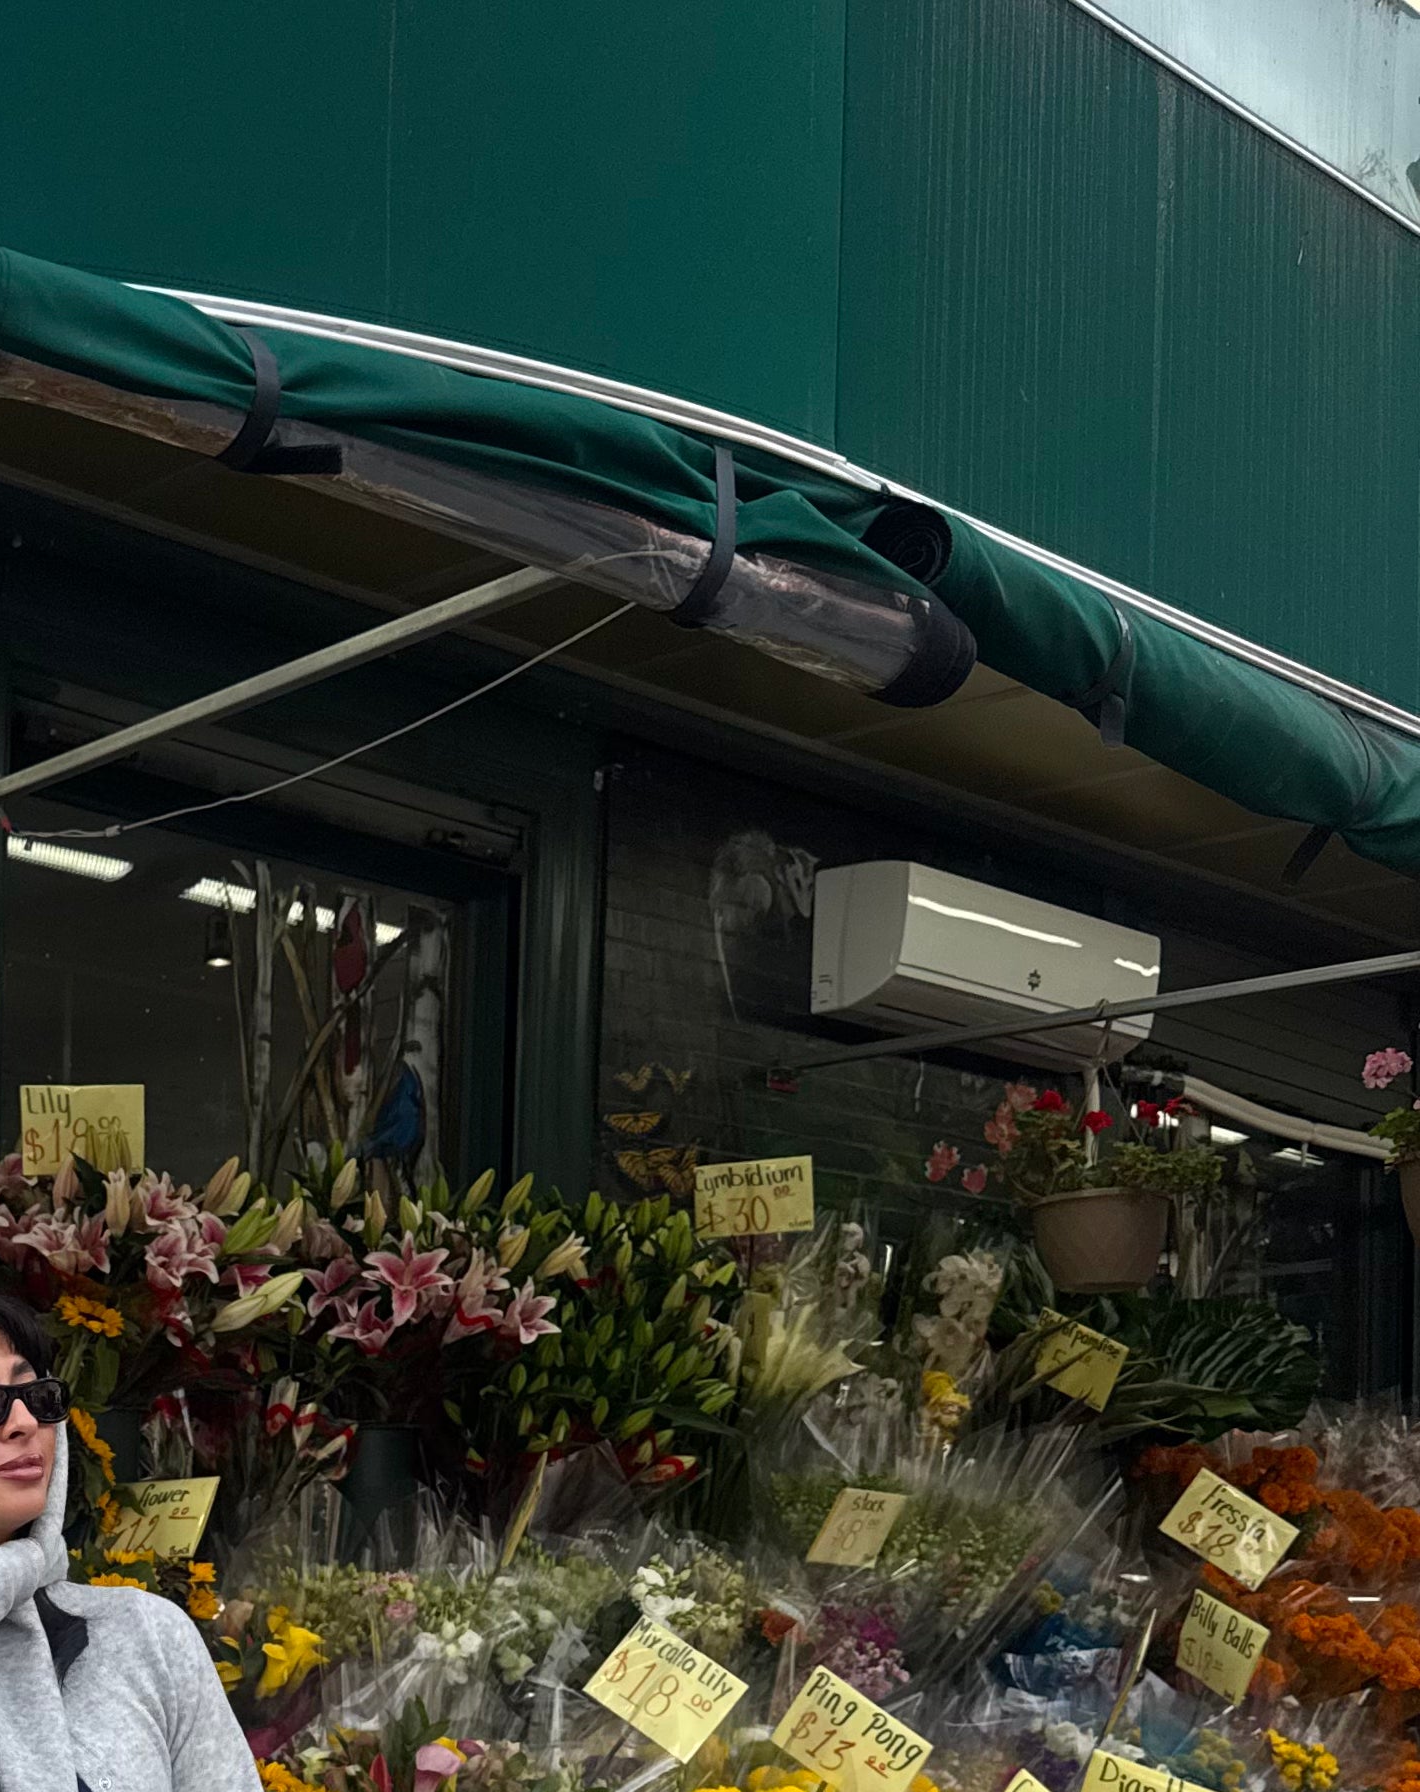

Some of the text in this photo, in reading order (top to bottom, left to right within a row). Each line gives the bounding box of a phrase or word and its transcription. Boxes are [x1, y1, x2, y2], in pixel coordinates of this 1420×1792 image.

[25, 1087, 70, 1128] Lily
[694, 1163, 803, 1198] Cymbidium
[1191, 1593, 1256, 1660] Billy Balls
[806, 1671, 923, 1771] Ping Pong
